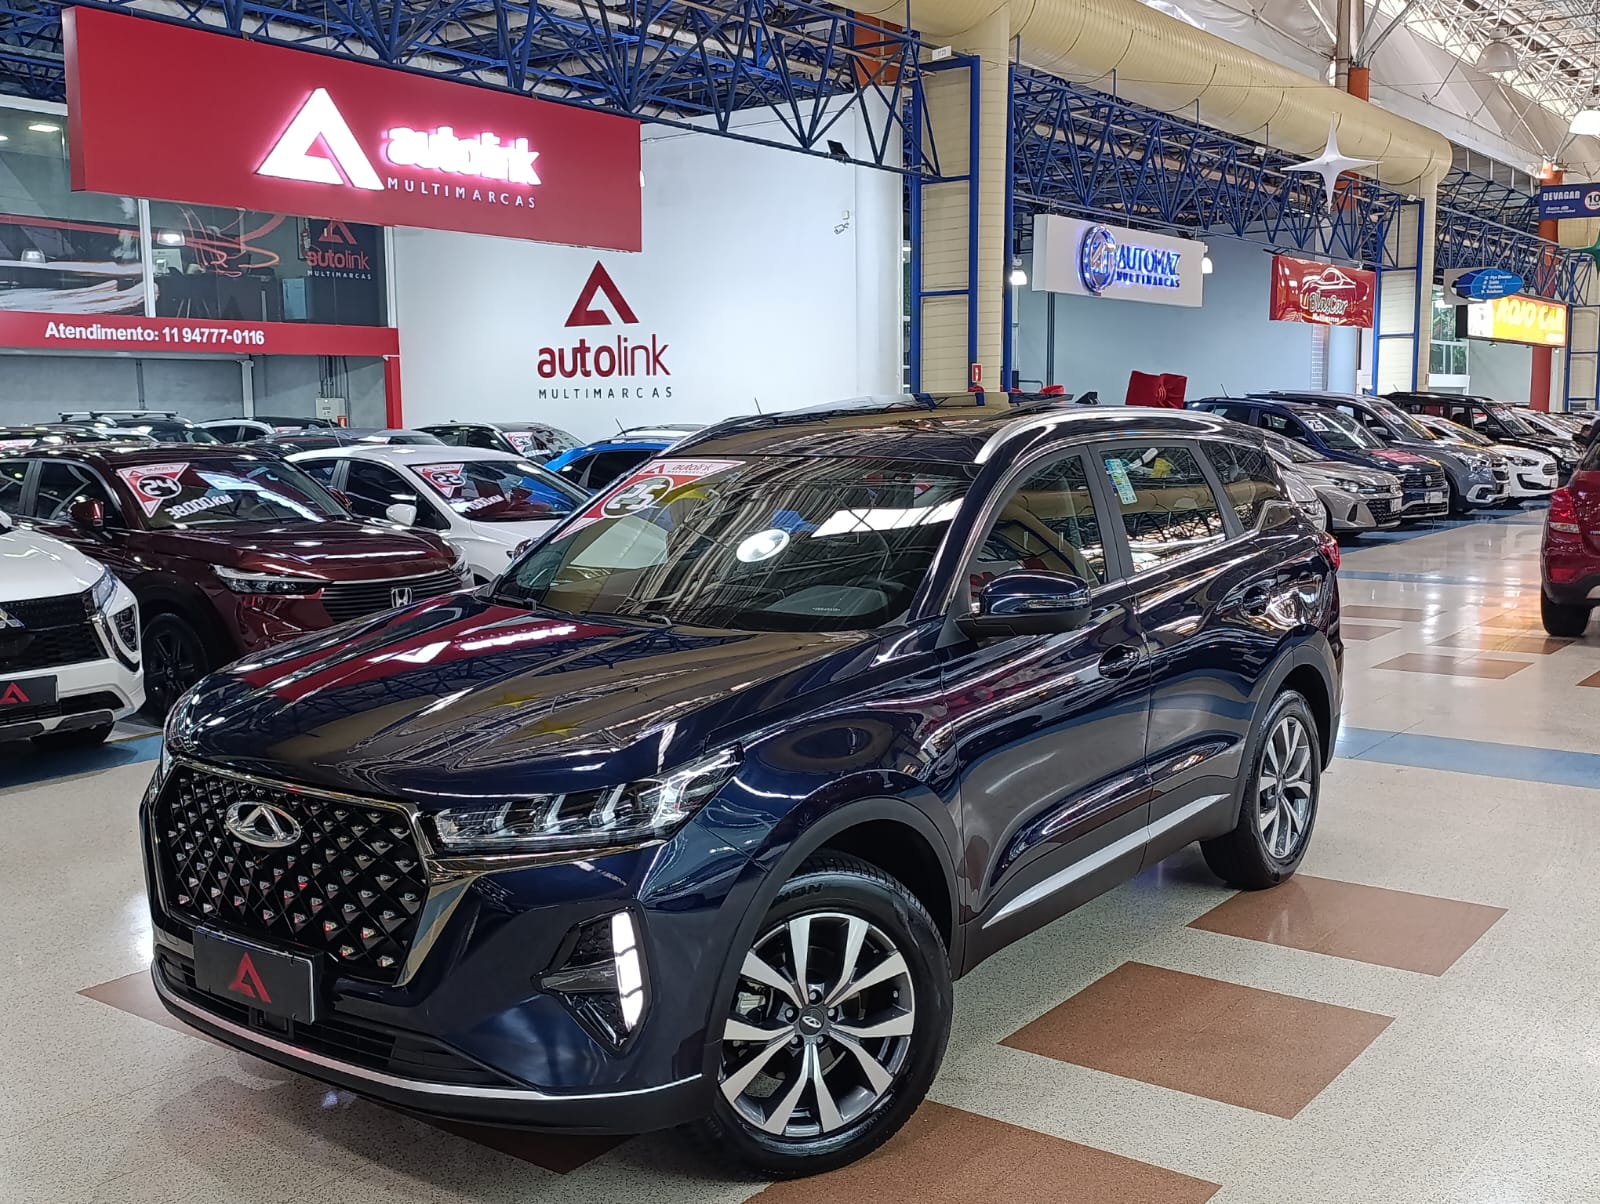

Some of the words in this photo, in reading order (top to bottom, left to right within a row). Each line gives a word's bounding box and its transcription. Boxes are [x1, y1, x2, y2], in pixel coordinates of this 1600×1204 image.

[387, 176, 537, 209] MULTIMARCAS
[306, 248, 371, 271] autolink
[1117, 243, 1181, 276] AUTOMAZ
[306, 270, 373, 281] MULTIMARCAS
[1116, 270, 1181, 288] MULTIMARCAS
[45, 321, 160, 342] Atendimento:
[162, 326, 180, 343] 11
[182, 327, 265, 345] 94777-0116
[537, 333, 673, 379] autolink
[538, 386, 673, 400] MULTIMARCAS
[142, 478, 178, 495] 24
[607, 484, 668, 511] 25
